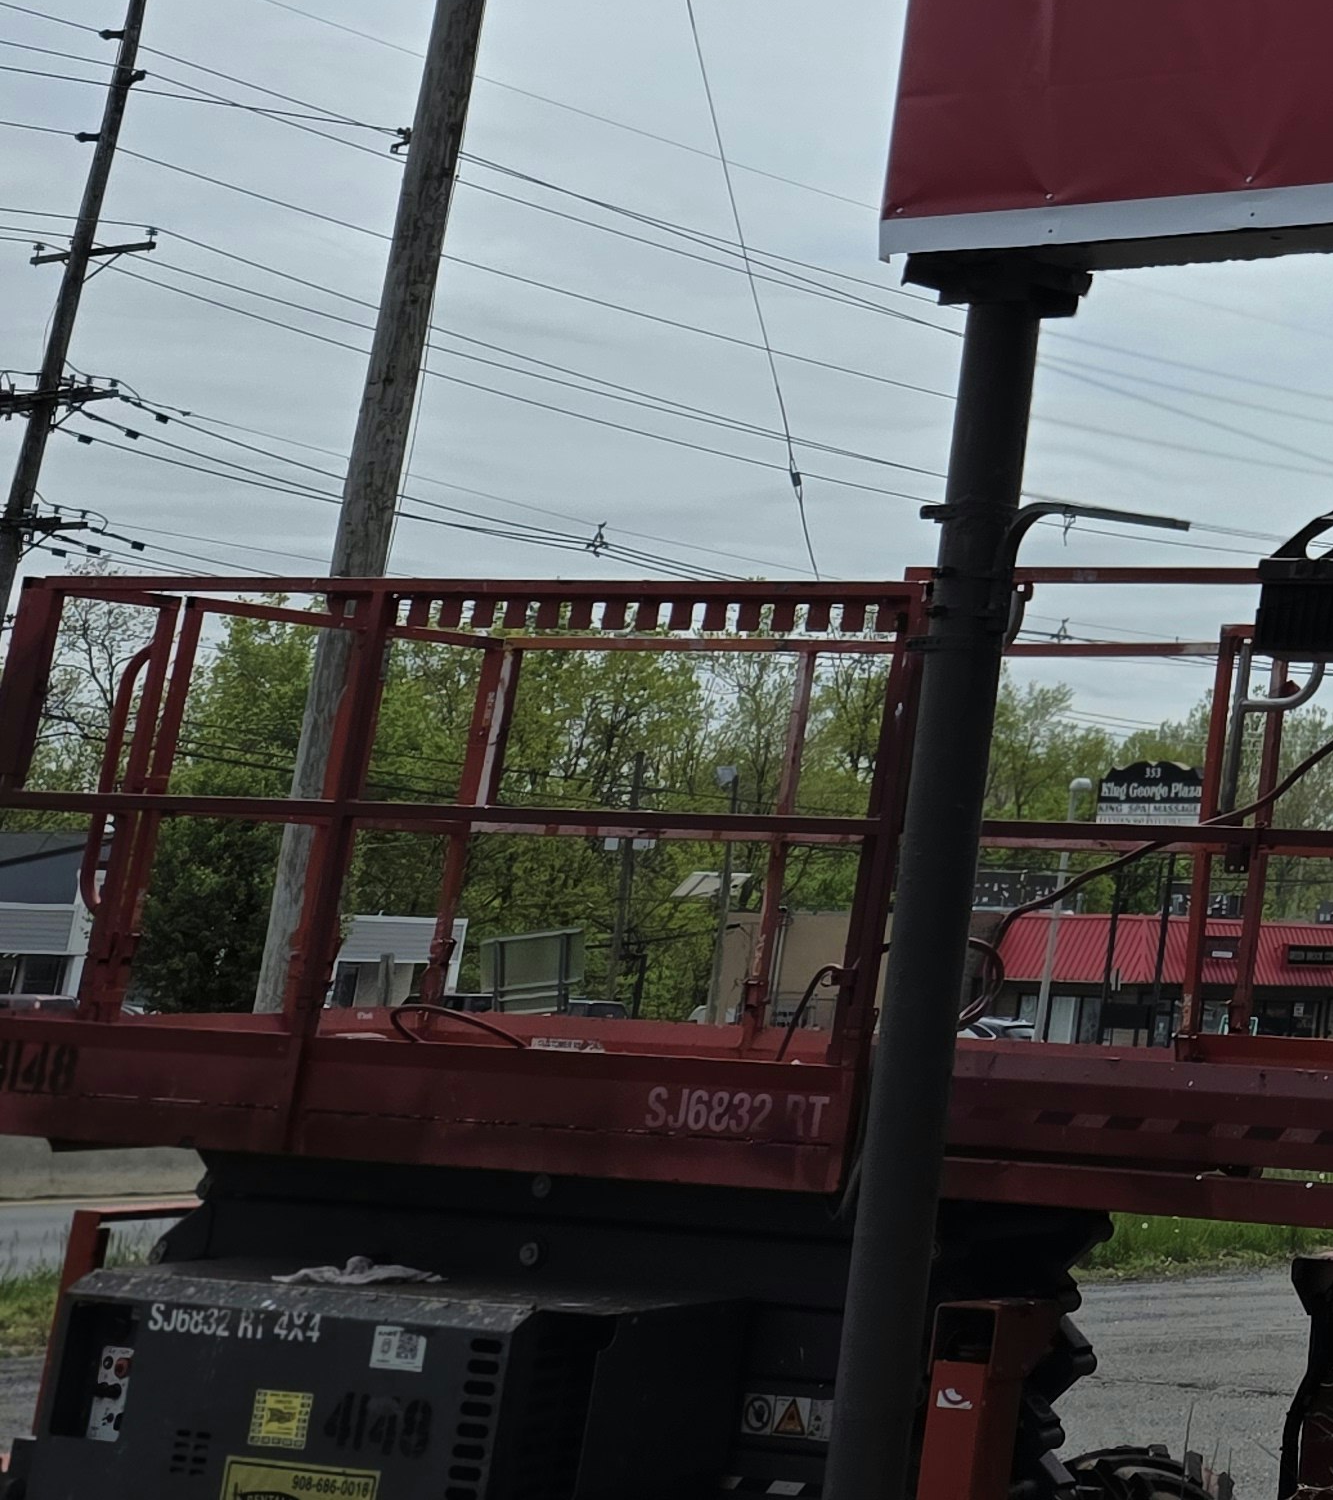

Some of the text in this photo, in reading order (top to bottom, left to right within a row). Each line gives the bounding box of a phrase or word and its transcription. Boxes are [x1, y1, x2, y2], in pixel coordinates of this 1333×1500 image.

[1144, 767, 1162, 779] 353
[1101, 782, 1203, 801] King George Plaza
[1098, 803, 1198, 814] KING SPA MASSAGE
[645, 1085, 774, 1135] SJ6832
[148, 1302, 230, 1338] SJ6832
